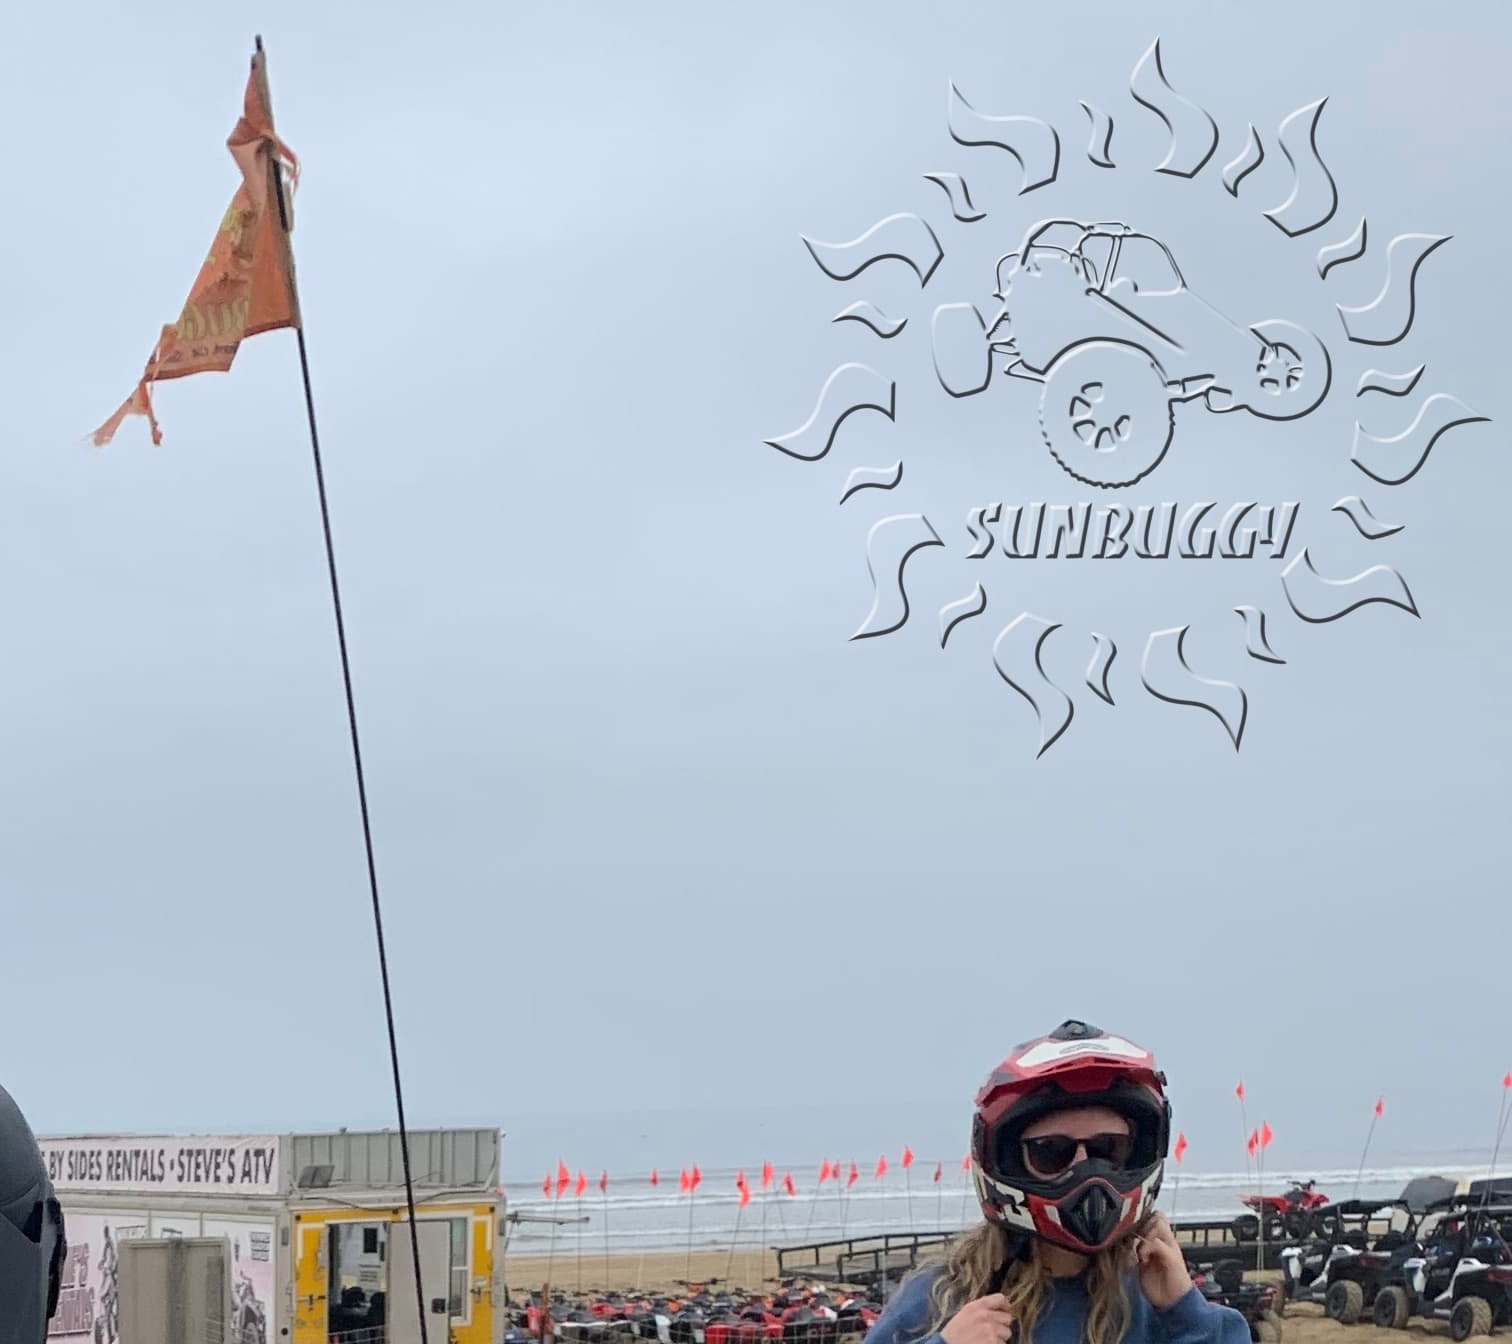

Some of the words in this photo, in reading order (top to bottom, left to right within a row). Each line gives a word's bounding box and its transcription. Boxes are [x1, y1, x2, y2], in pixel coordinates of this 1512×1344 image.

[49, 1150, 66, 1182] BY
[67, 1149, 102, 1182] SIDES
[106, 1149, 165, 1184] RENTALS
[177, 1149, 236, 1184] STEVE'S
[240, 1148, 276, 1185] ATV
